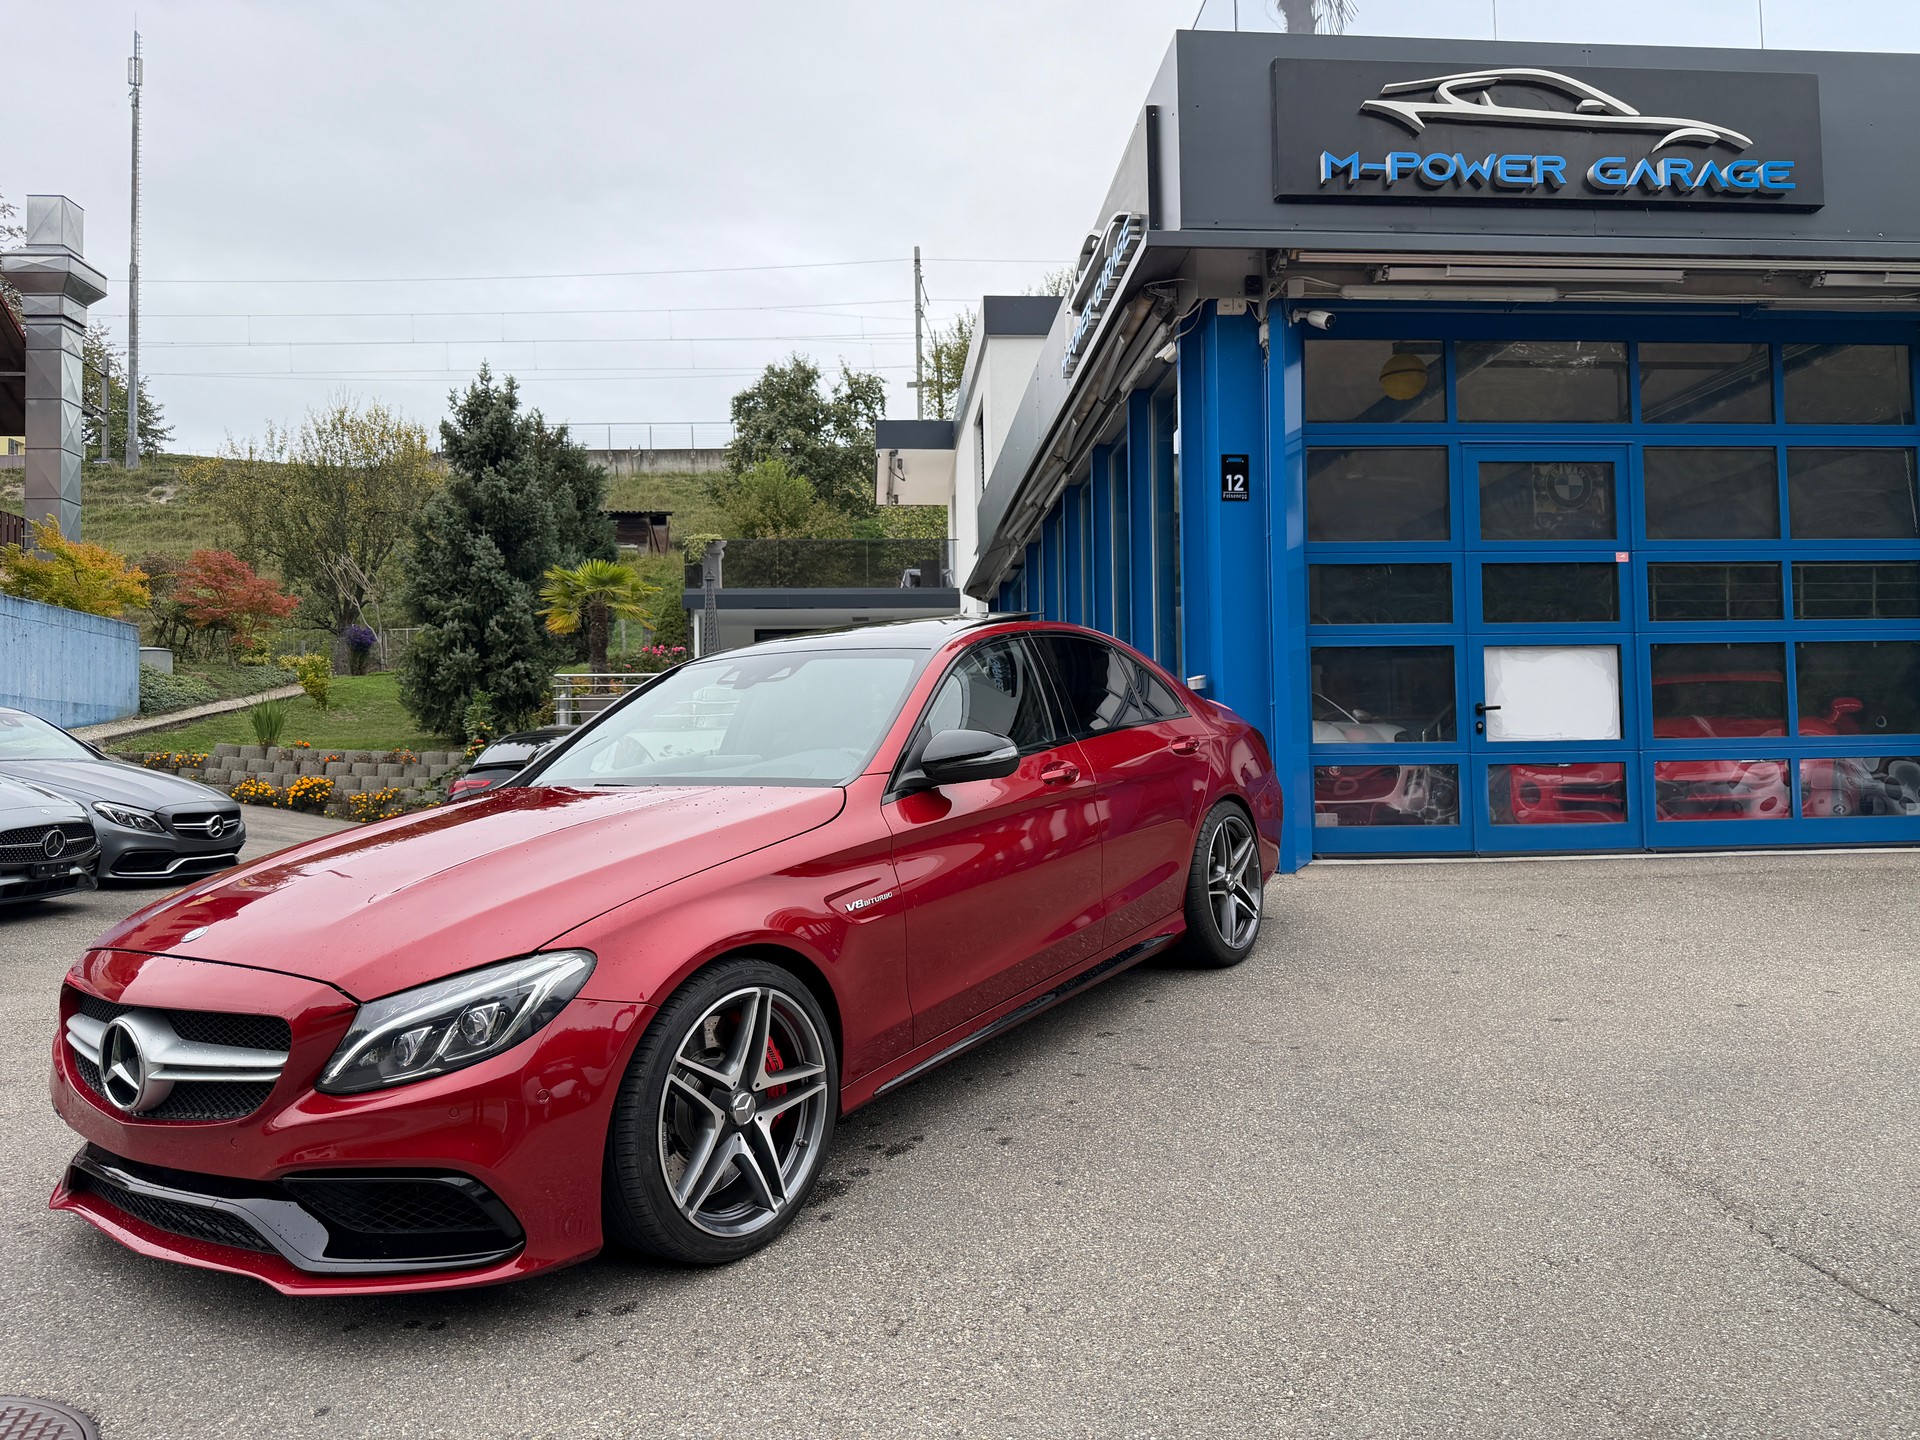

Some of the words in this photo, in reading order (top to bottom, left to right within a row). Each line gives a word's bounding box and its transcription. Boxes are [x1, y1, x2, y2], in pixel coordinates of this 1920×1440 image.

[1320, 150, 1567, 187] M-POWER
[1588, 155, 1796, 191] GARAGE
[1094, 214, 1131, 307] GARAGE
[1226, 474, 1244, 491] 12
